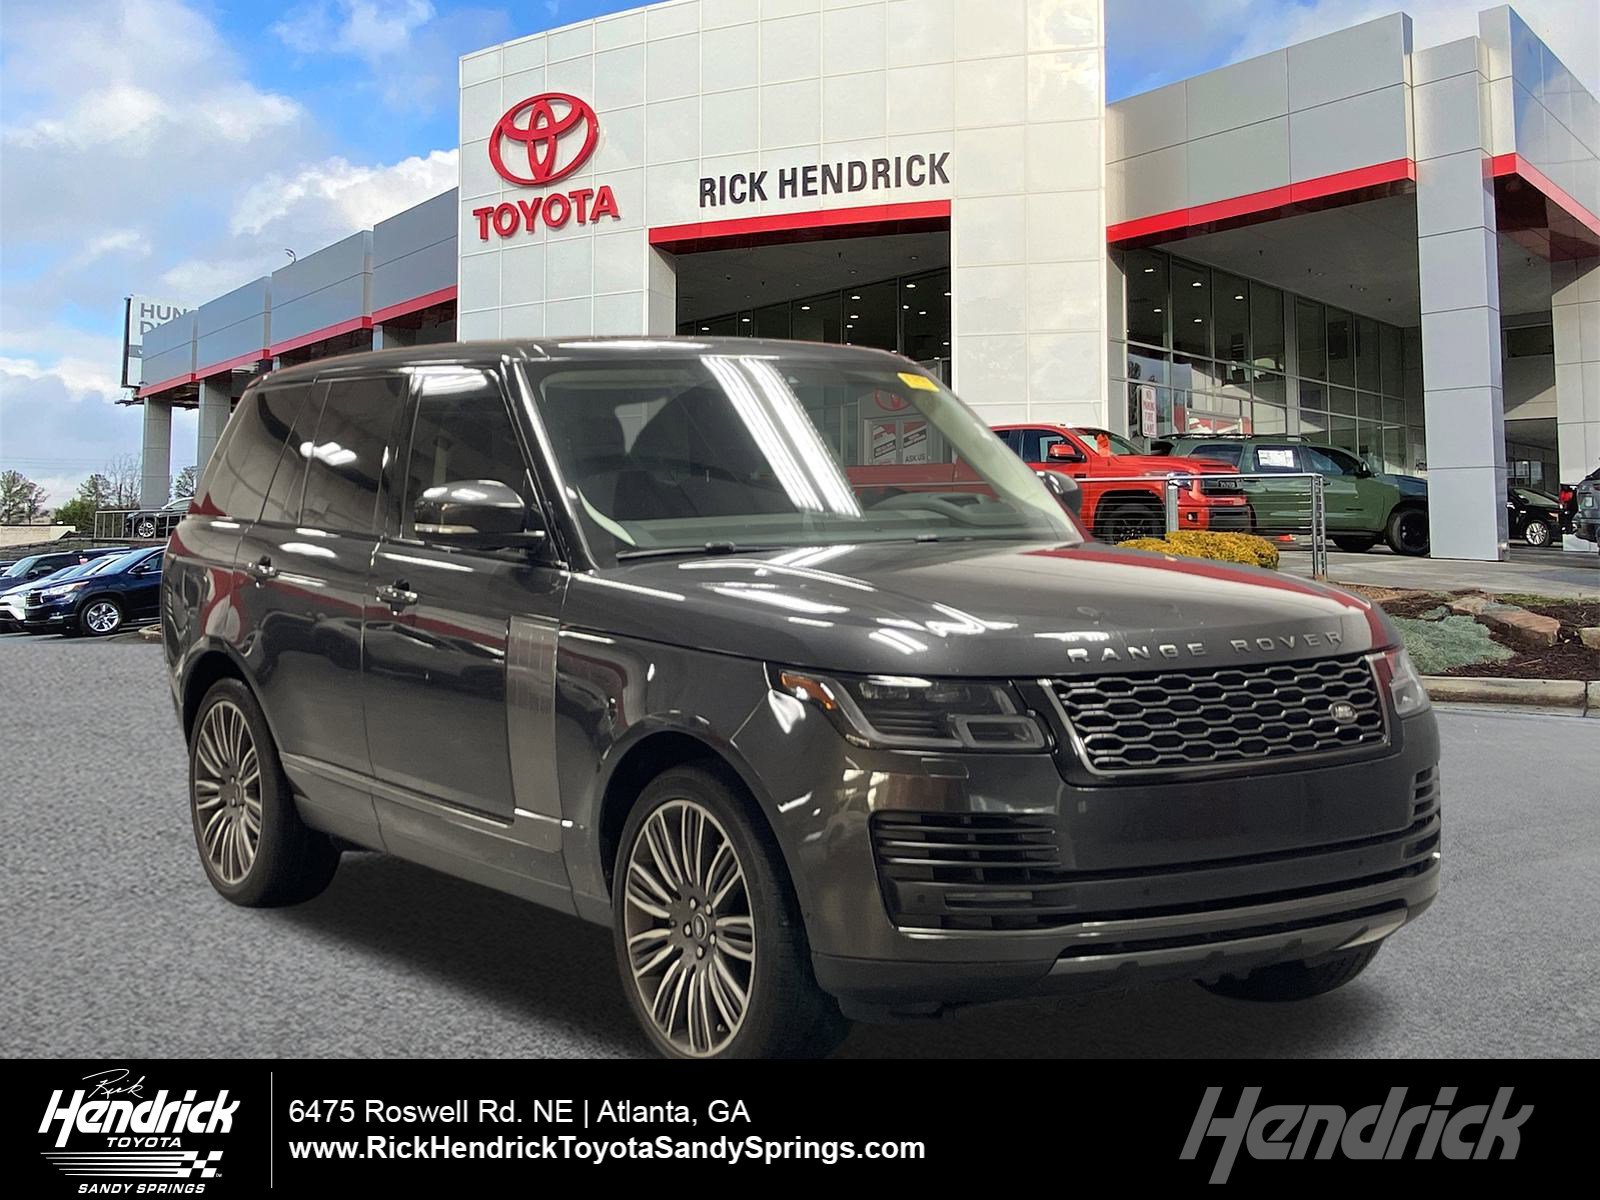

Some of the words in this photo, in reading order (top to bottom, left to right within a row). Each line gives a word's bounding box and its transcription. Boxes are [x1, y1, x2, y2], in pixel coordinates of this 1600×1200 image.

[699, 171, 768, 208] RICK
[779, 152, 951, 199] HENDRICK
[472, 185, 620, 240] TOYOTA
[1067, 642, 1207, 663] RANGE
[1230, 631, 1343, 653] ROVER
